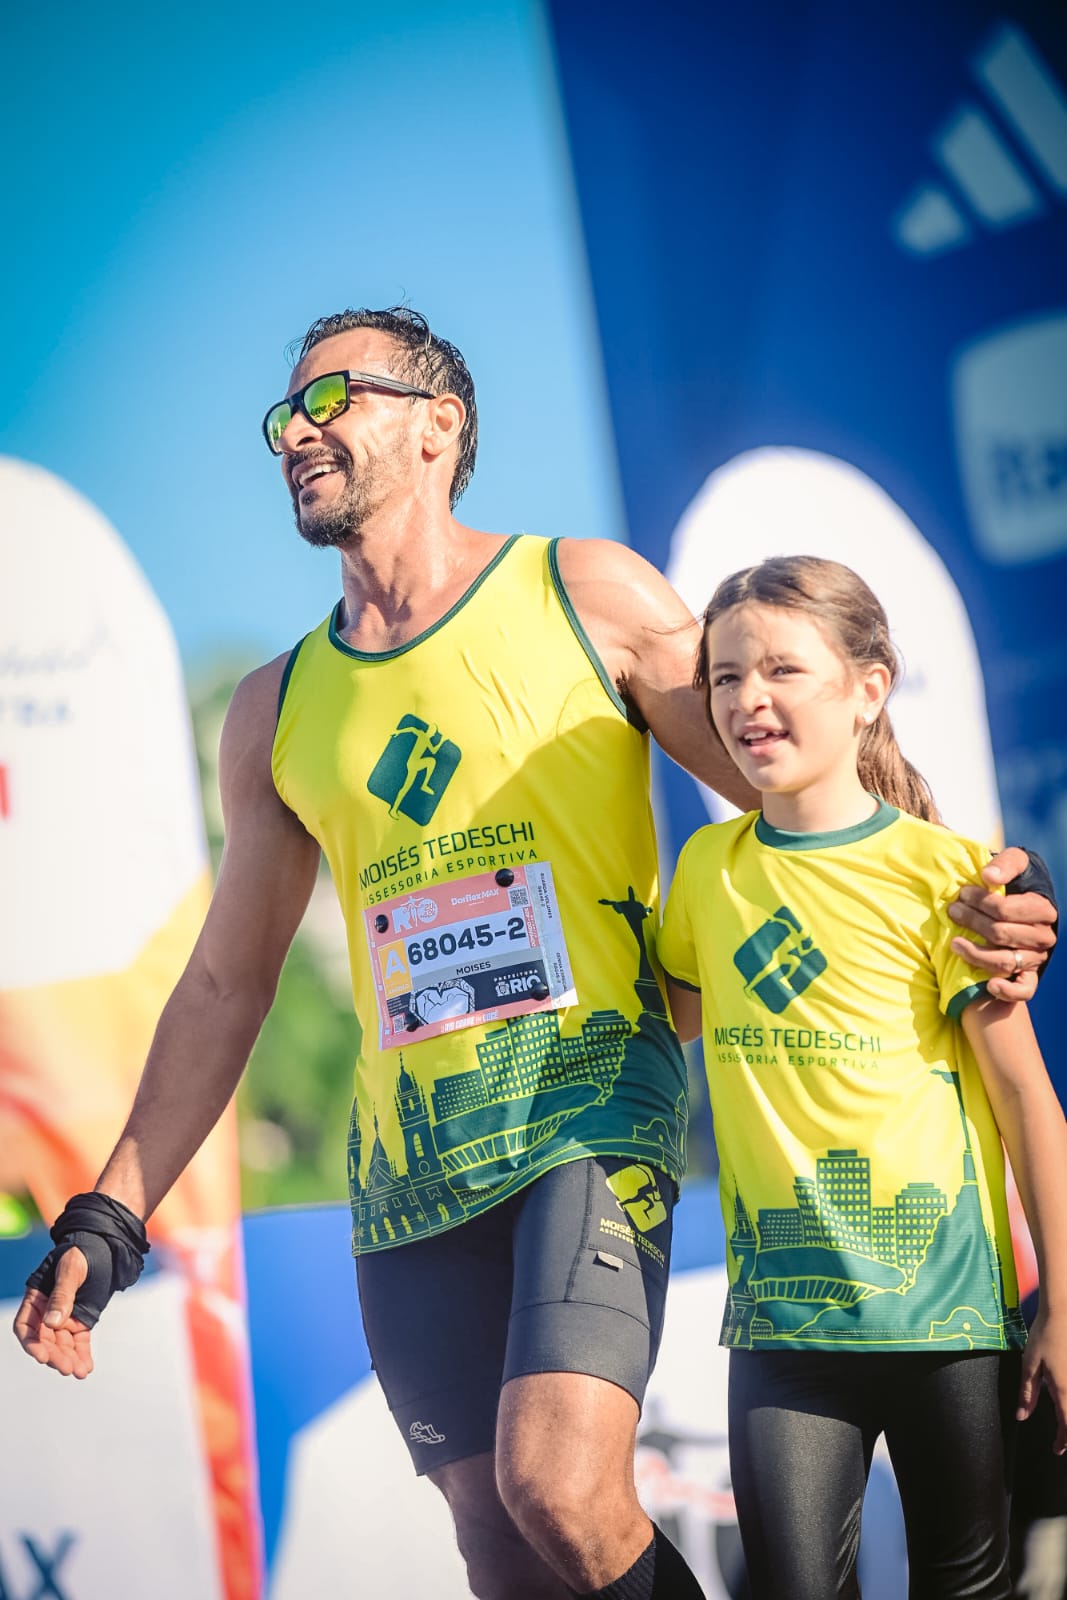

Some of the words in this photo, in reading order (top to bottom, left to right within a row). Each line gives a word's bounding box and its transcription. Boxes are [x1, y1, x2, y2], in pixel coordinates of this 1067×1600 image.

[359, 846, 420, 890] MOISÉS
[423, 821, 535, 859] TEDESCHI
[446, 849, 537, 873] ESPORTIVA
[408, 917, 527, 965] 68045-2
[385, 949, 406, 979] A
[456, 961, 491, 975] MOISES
[769, 1028, 882, 1053] TEDESCHI
[788, 1055, 879, 1070] ESPORTIVA
